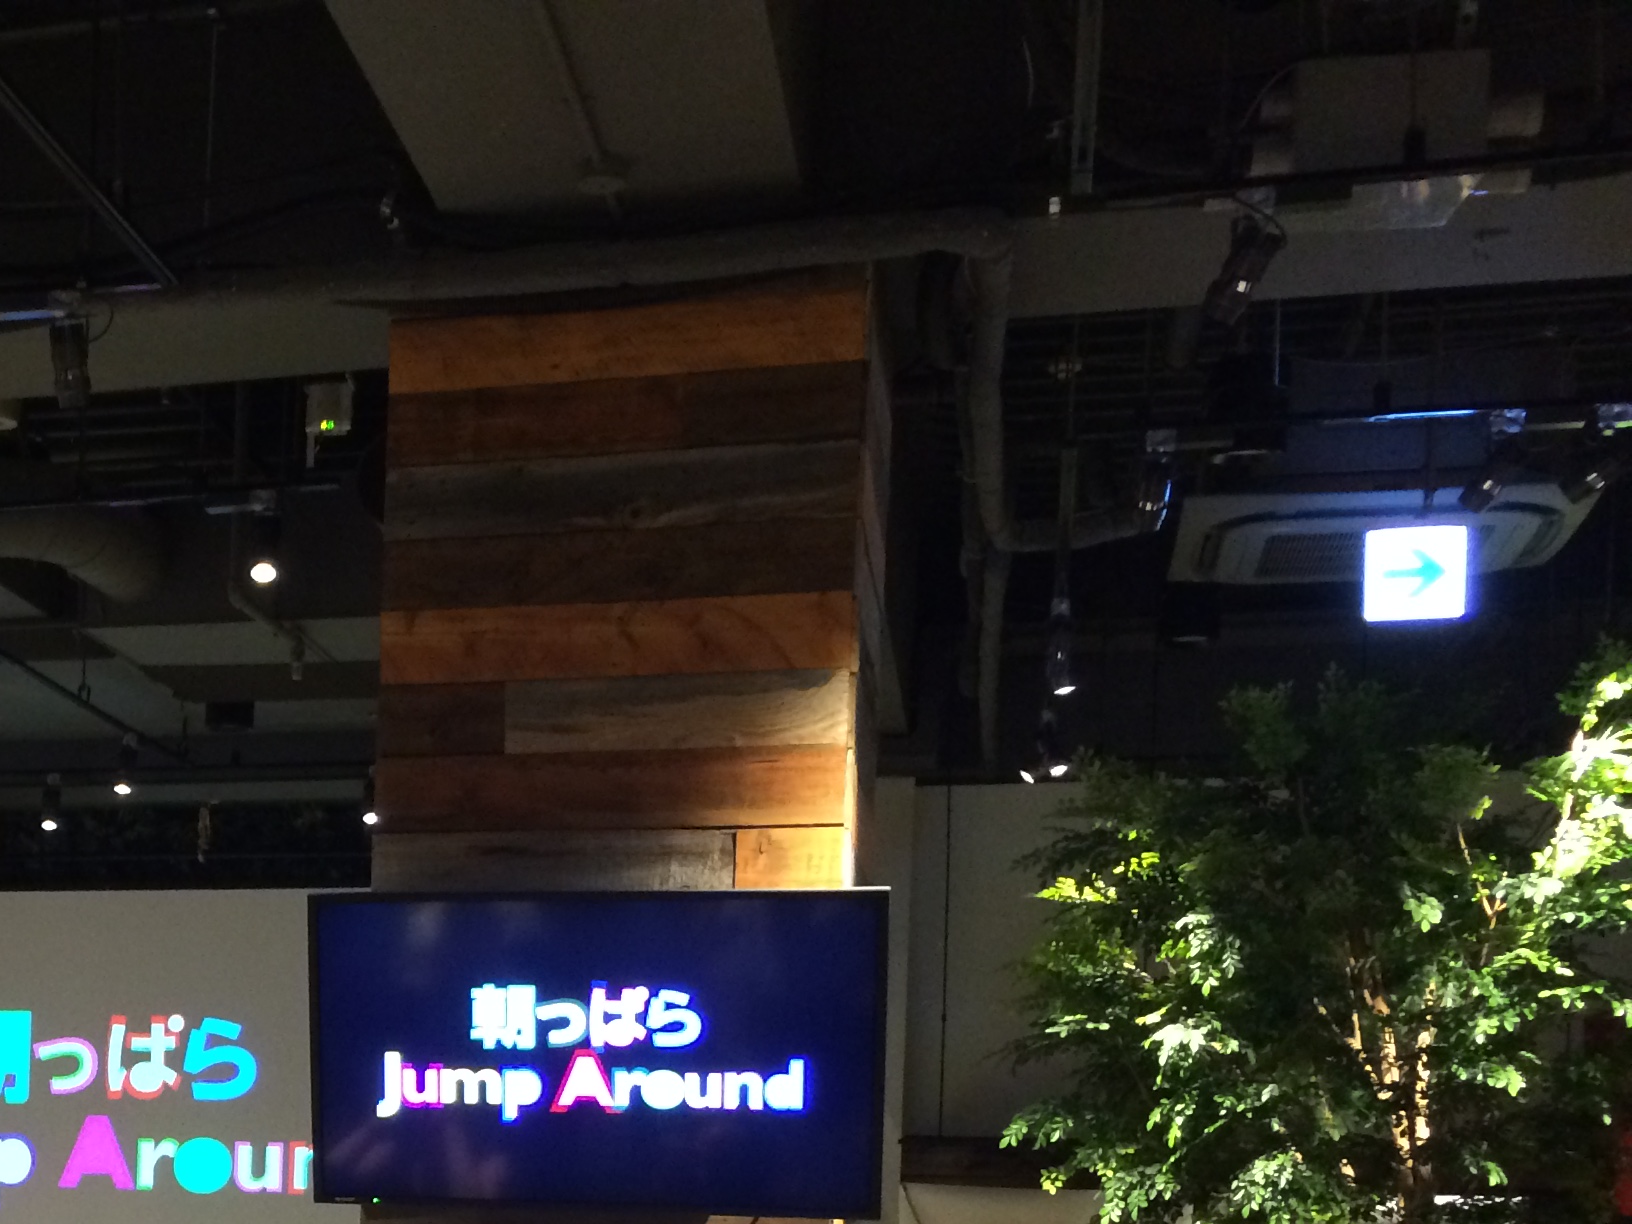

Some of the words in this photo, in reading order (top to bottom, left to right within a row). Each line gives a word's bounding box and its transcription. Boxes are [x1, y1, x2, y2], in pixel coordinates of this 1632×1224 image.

[470, 982, 701, 1052] 朝っぱら
[377, 1052, 541, 1121] Jump
[551, 1049, 809, 1114] Around
